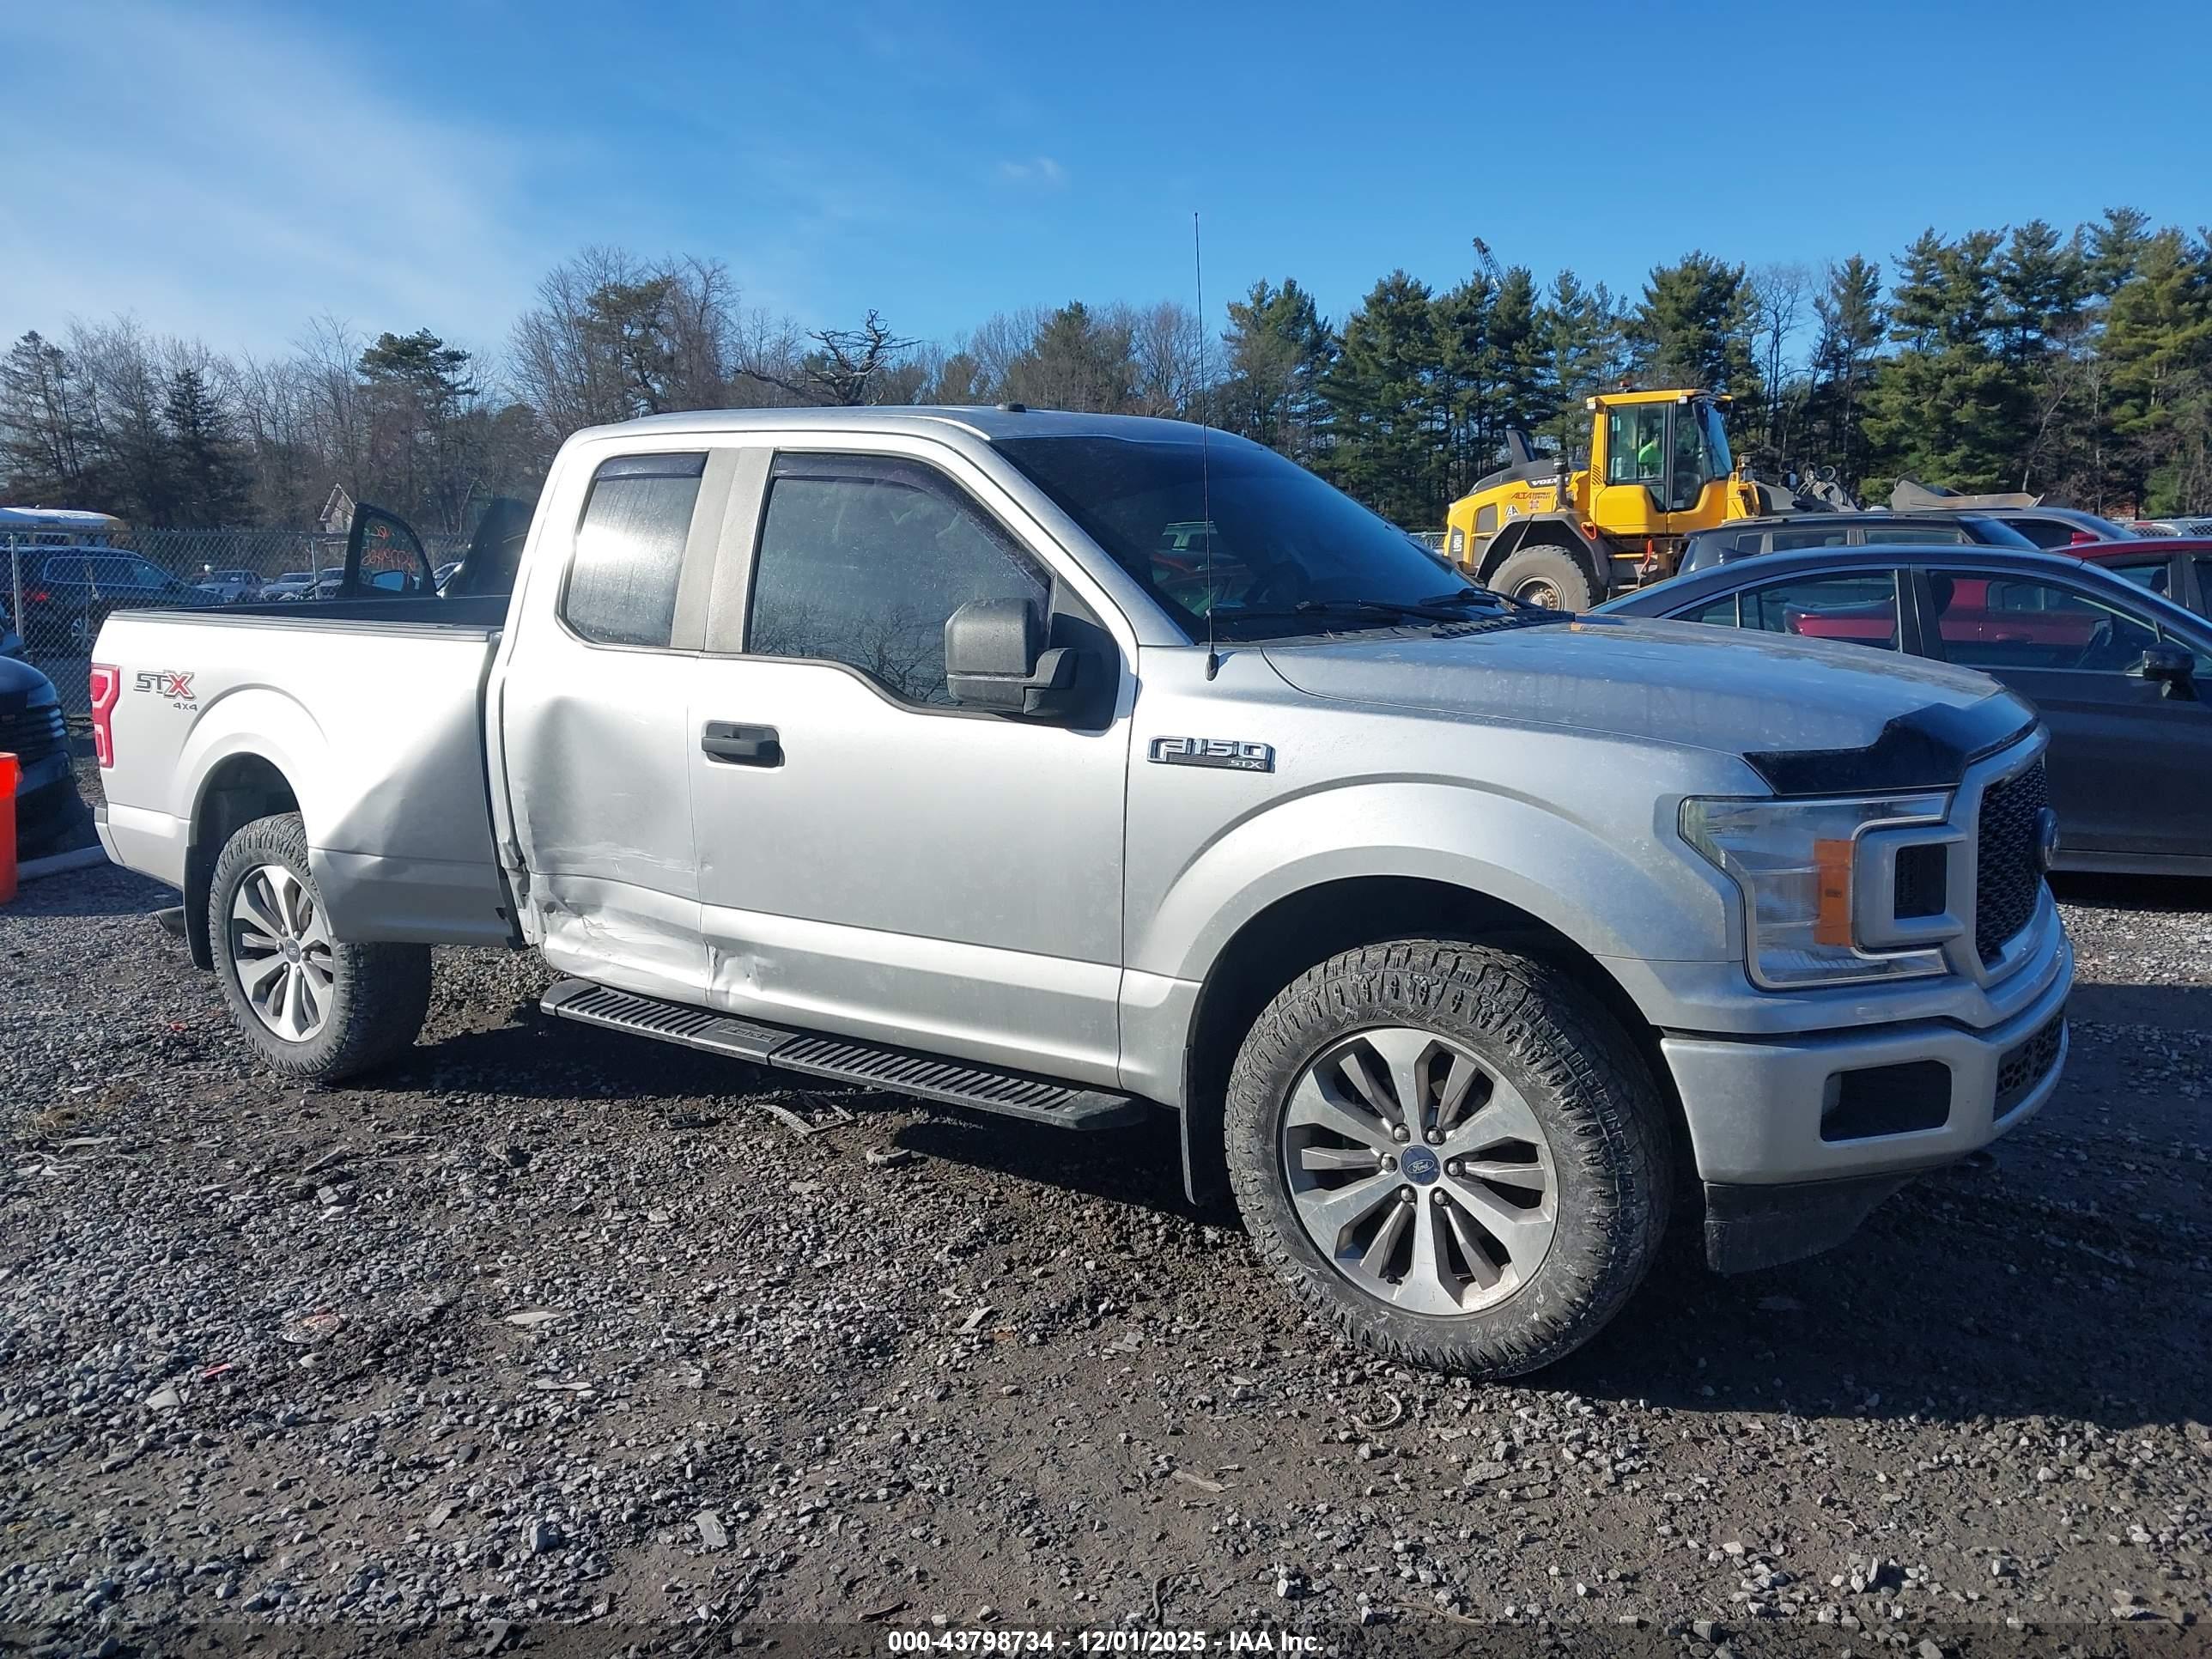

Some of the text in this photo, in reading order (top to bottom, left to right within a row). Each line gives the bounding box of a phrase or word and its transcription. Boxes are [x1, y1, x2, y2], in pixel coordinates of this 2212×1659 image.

[1453, 534, 1463, 551] L90H
[134, 670, 196, 701] STX
[1229, 759, 1265, 769] STX
